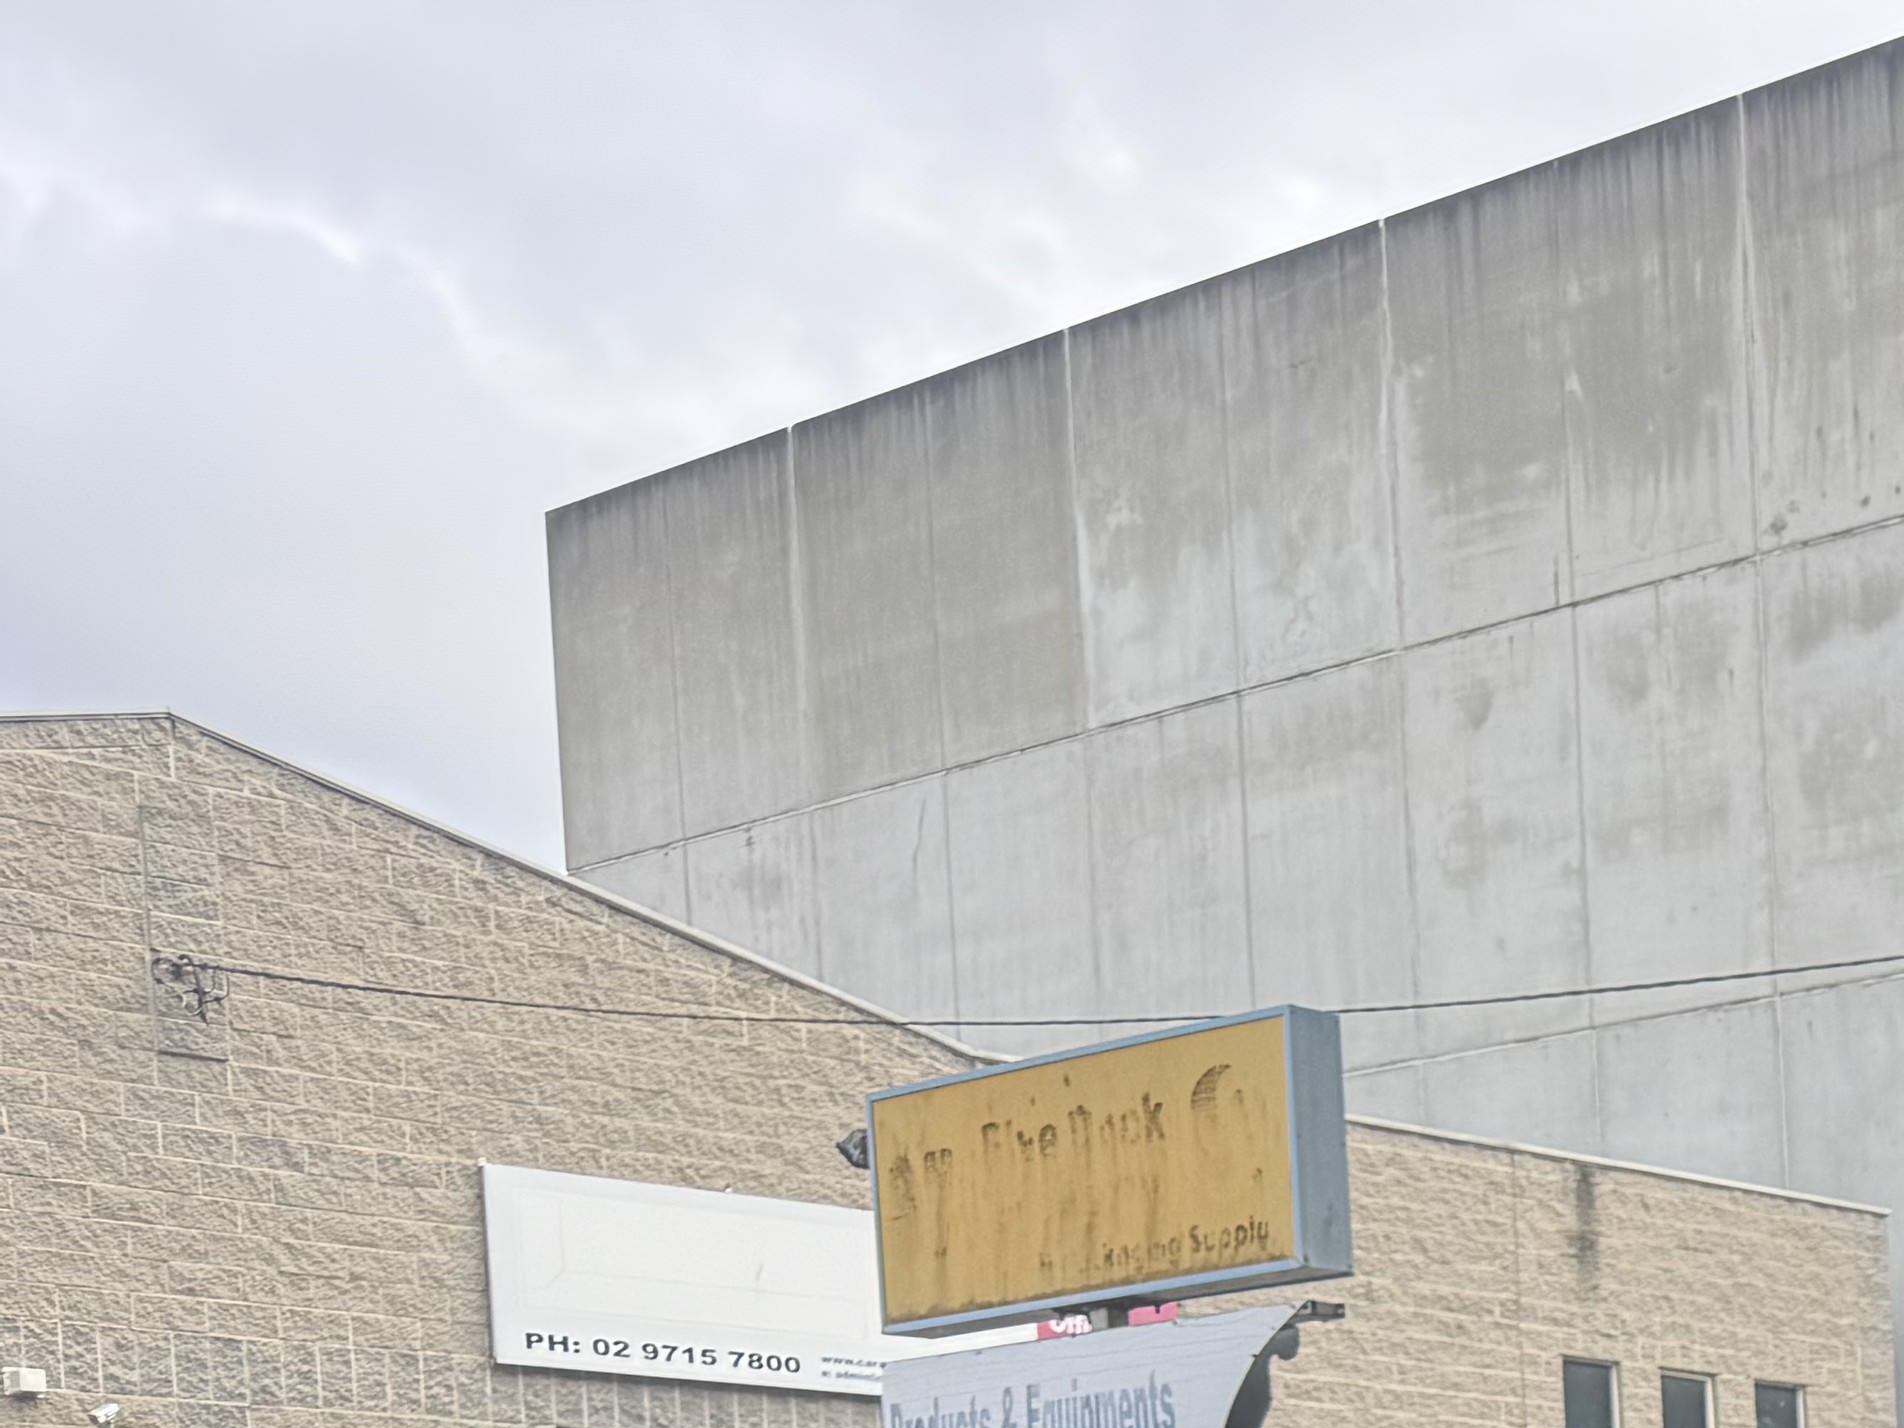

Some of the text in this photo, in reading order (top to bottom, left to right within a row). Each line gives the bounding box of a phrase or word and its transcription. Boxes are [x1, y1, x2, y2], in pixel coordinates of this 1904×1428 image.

[525, 1332, 801, 1374] PH: 02 9715 7800
